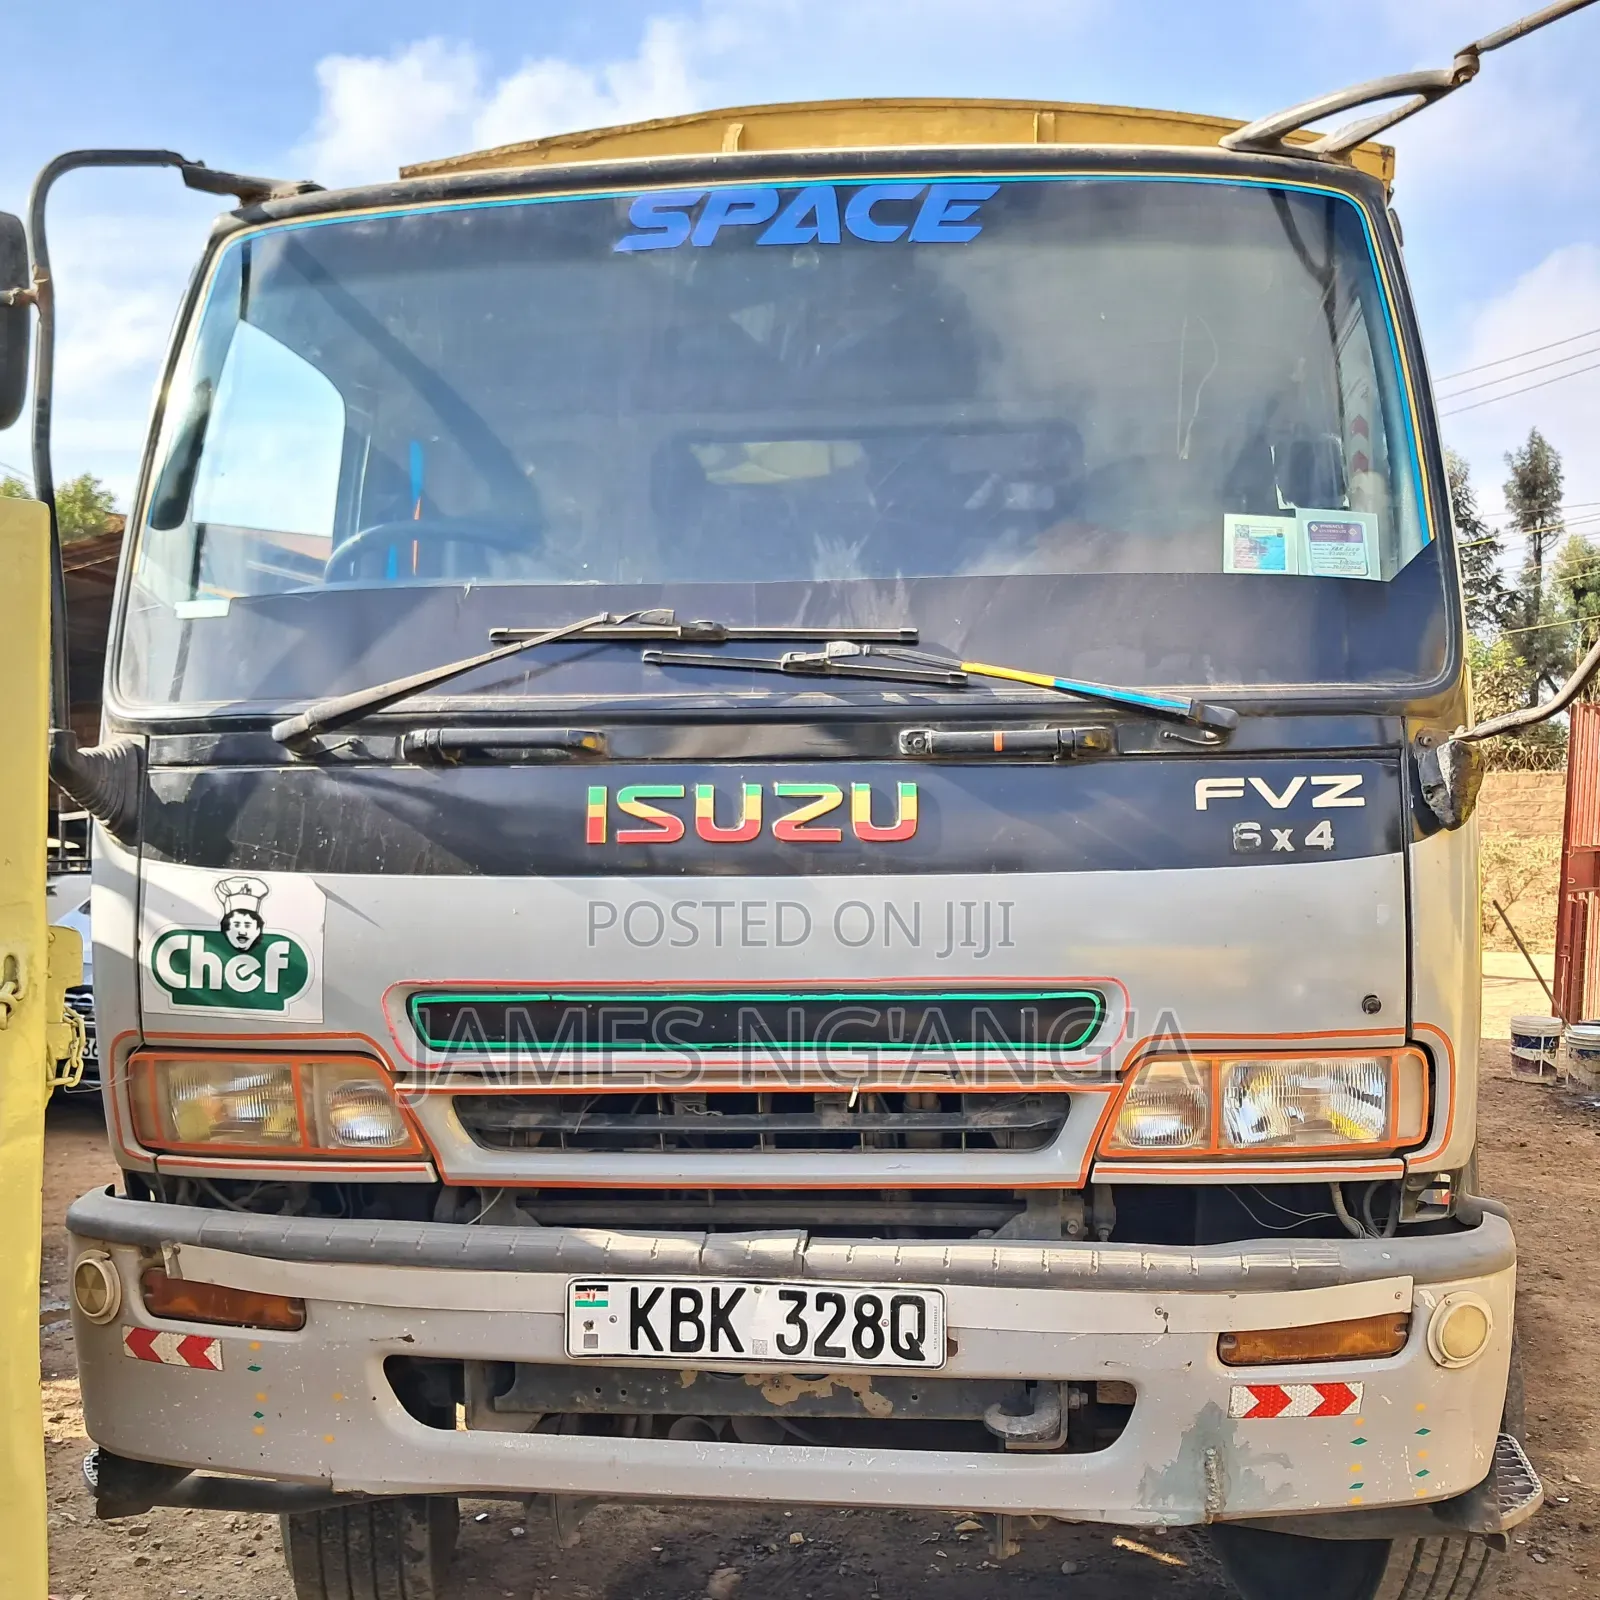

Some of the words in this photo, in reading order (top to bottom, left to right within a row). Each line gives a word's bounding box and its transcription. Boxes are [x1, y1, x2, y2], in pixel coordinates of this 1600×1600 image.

[613, 184, 1001, 252] SPACE
[585, 782, 918, 844] ISUZU
[1194, 774, 1366, 812] FVZ
[154, 934, 291, 994] Chef
[629, 1286, 747, 1353] KBK
[775, 1289, 927, 1362] 328Q
